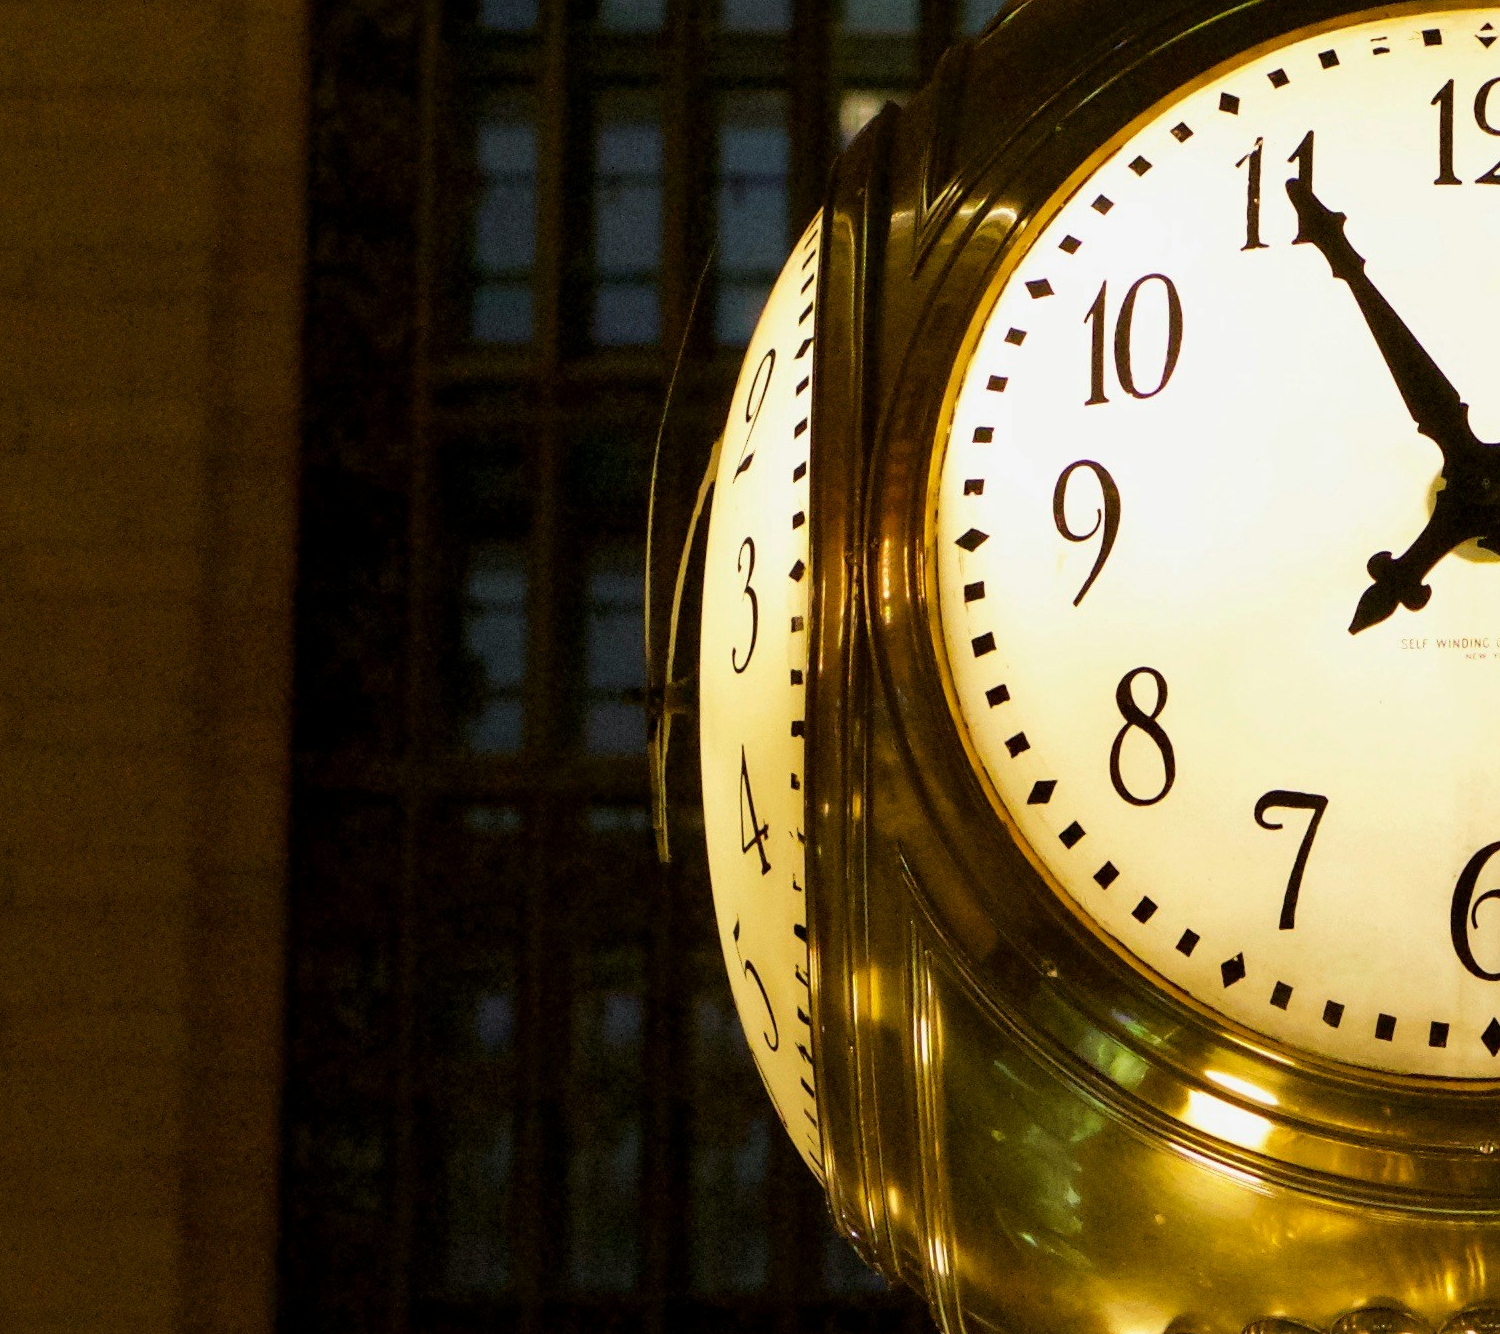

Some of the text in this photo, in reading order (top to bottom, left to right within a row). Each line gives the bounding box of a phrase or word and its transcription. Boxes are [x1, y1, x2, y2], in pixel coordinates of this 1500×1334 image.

[1235, 130, 1318, 251] 11
[1083, 273, 1183, 406] 10
[732, 348, 777, 484] 2
[1052, 459, 1121, 607] 9
[731, 535, 759, 675] 3
[1401, 638, 1429, 649] SELF
[1437, 637, 1490, 649] WINDING
[1465, 652, 1487, 660] NEW
[1109, 666, 1176, 807] 8
[740, 743, 772, 876] 4
[1253, 789, 1329, 931] 7
[732, 912, 779, 1053] 5
